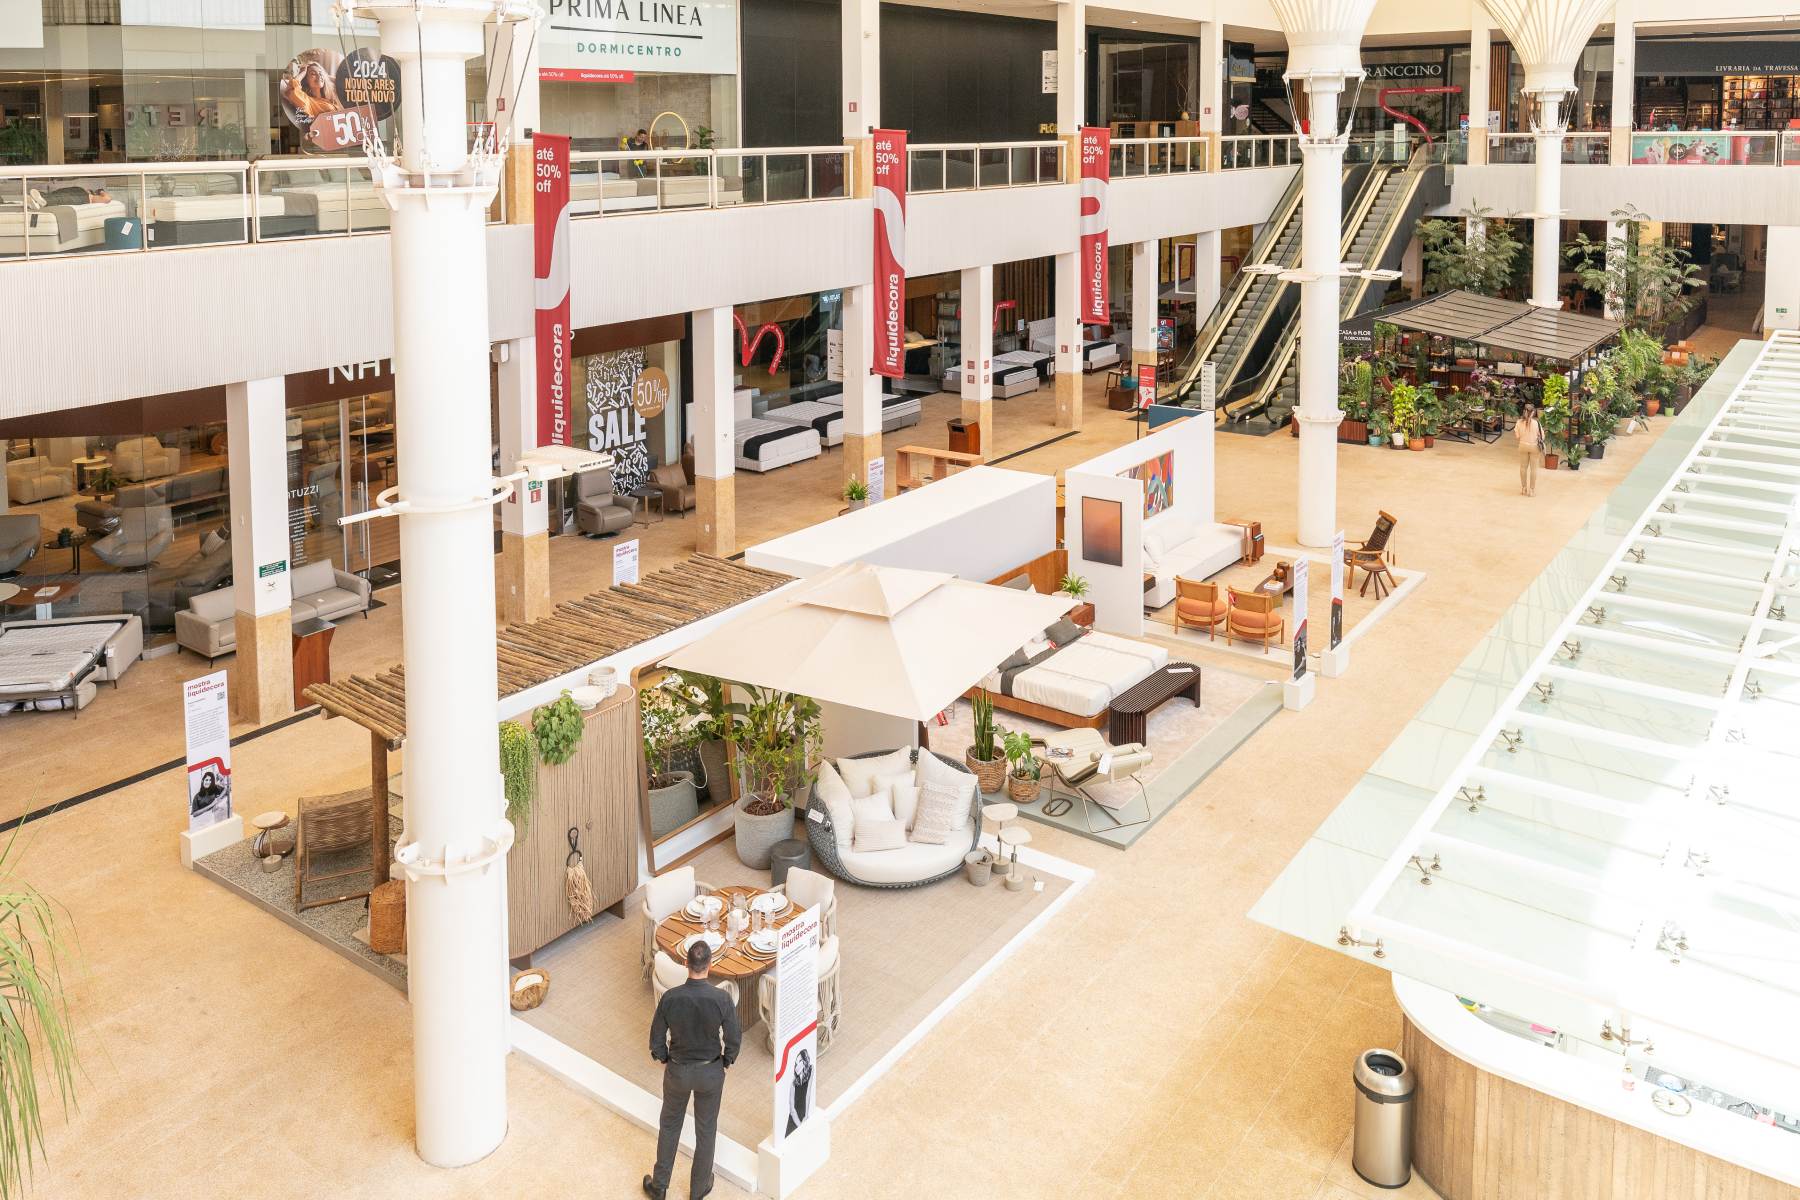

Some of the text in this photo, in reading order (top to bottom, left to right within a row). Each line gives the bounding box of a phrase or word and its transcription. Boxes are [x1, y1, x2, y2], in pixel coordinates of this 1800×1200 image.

[550, 0, 703, 27] PRIMA LINEA
[577, 42, 682, 57] DORMICENTRO
[353, 60, 387, 78] 2024
[1364, 65, 1442, 77] RANCCINO
[345, 78, 395, 91] NOVOS ARES
[345, 90, 395, 103] TUDO NOVO
[876, 140, 892, 151] até
[1083, 135, 1098, 145] até
[536, 147, 554, 161] até
[1083, 145, 1104, 155] 50%
[876, 152, 899, 164] 50%
[1083, 155, 1095, 164] off
[536, 163, 562, 179] 50%
[876, 165, 890, 175] off
[536, 179, 552, 193] off
[1092, 242, 1105, 316] liquidecora
[886, 273, 901, 367] liquidecora
[551, 323, 566, 445] liquidecora
[589, 407, 647, 452] SALE
[187, 680, 211, 691] mostra
[187, 682, 225, 697] liquidecora
[781, 921, 805, 941] mostra
[781, 921, 818, 950] liquidecora
